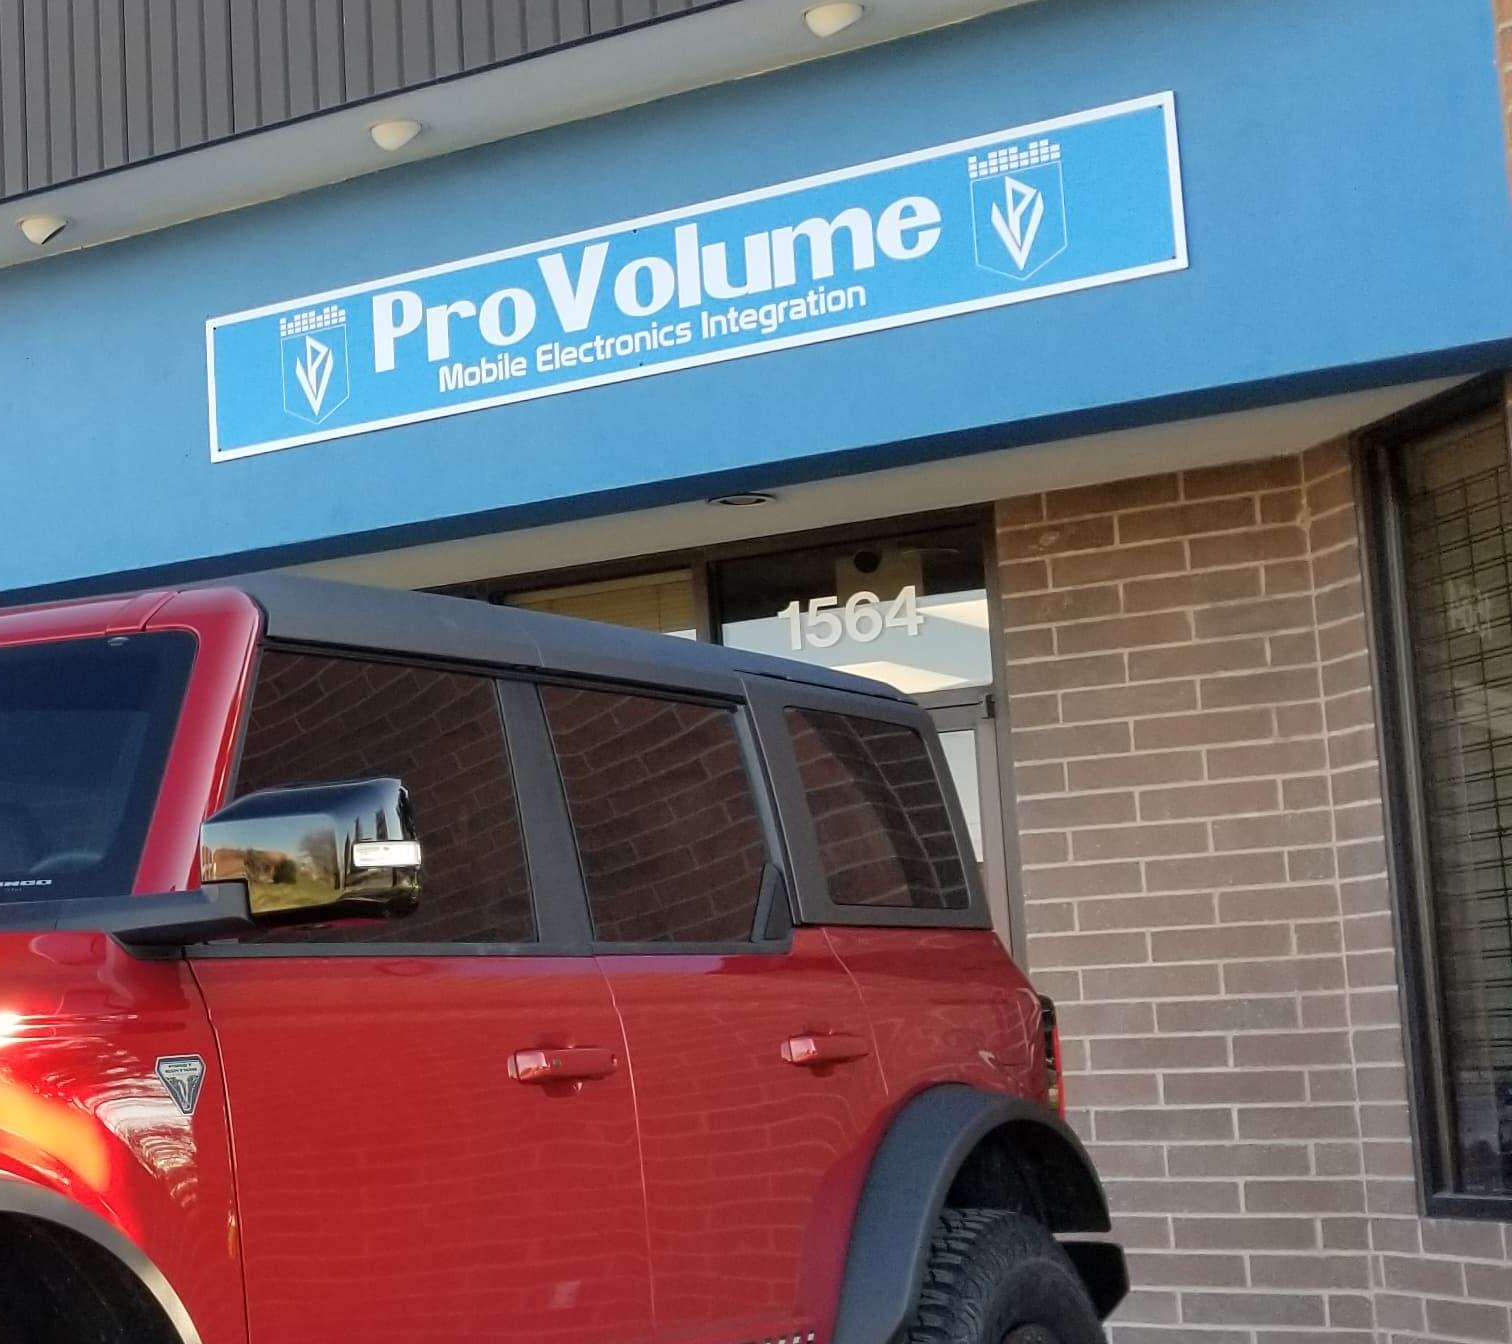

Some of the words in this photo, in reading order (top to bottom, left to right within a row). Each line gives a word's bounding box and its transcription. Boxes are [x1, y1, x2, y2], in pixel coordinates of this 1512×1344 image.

[439, 352, 528, 393] Mobile
[536, 320, 692, 374] Electronics
[700, 284, 866, 342] Integration
[777, 585, 924, 651] 1564
